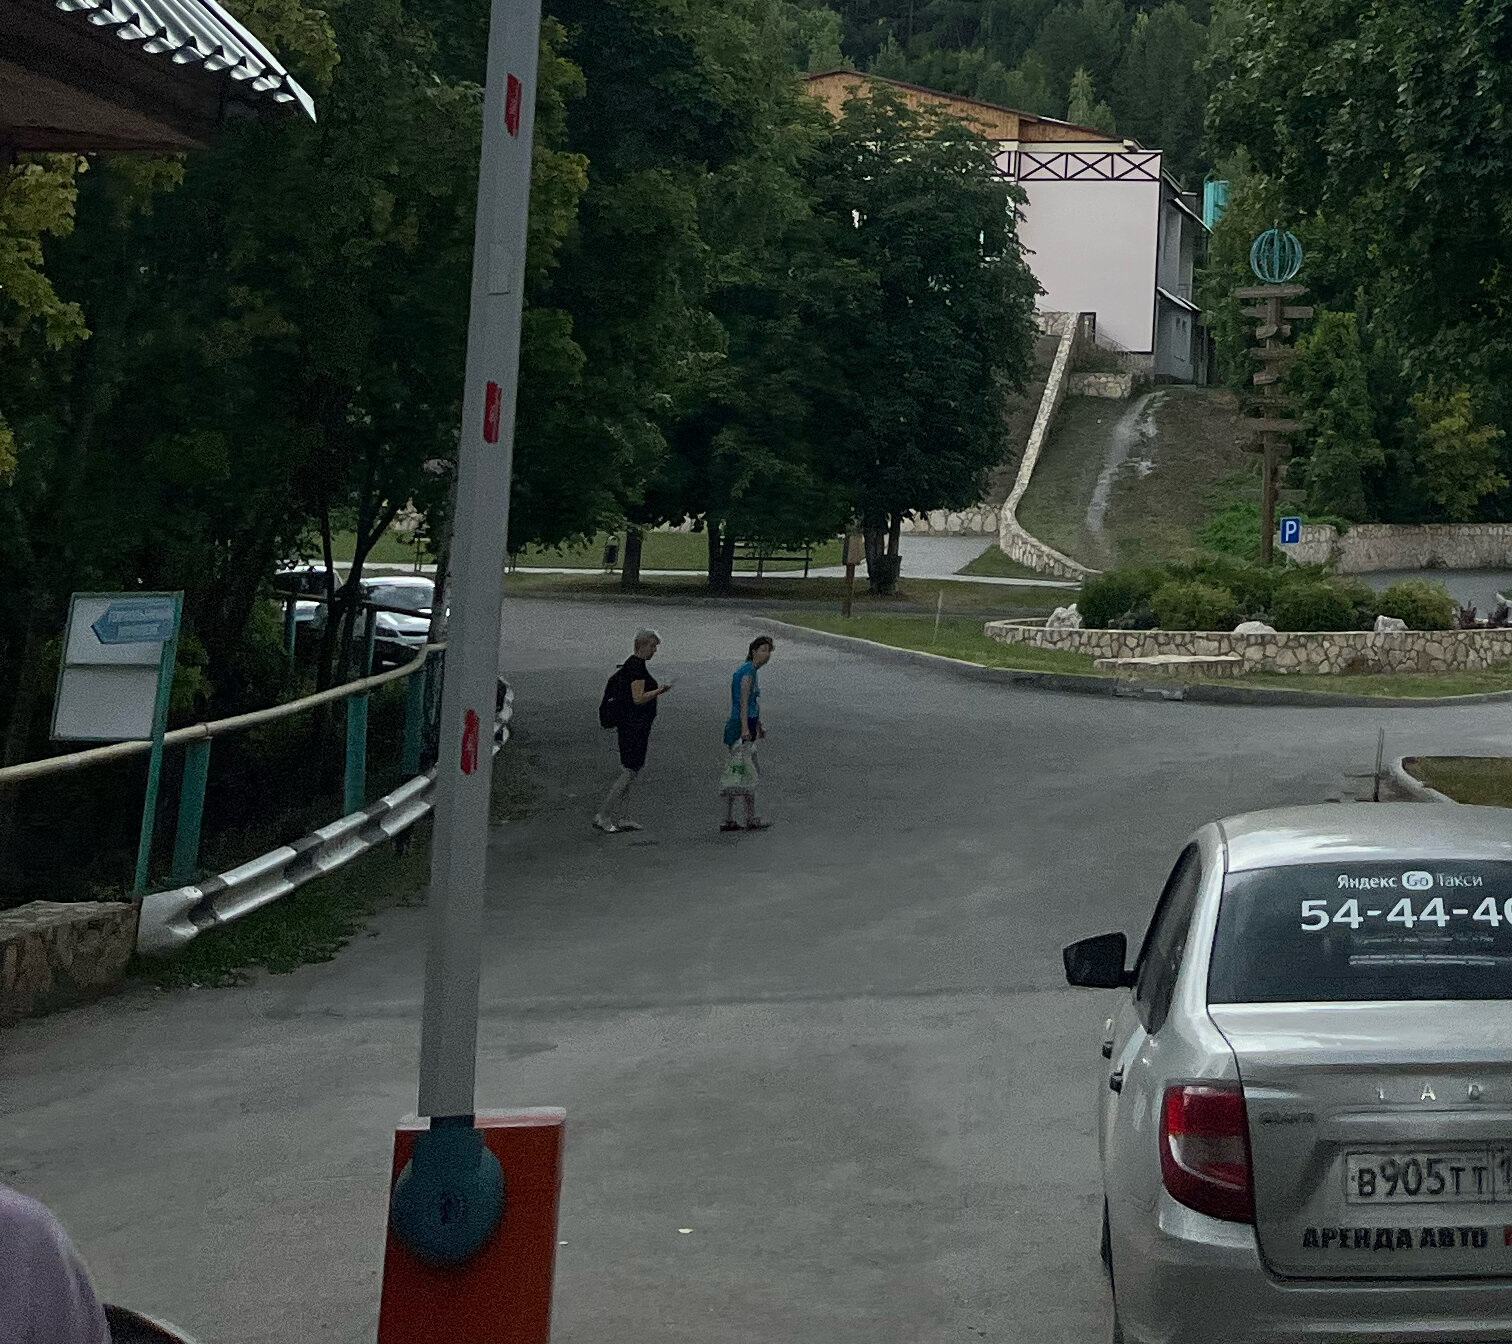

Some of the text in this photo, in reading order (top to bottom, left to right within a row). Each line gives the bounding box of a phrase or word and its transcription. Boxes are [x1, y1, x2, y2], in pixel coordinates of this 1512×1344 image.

[1285, 520, 1298, 542] P
[1337, 874, 1398, 890] Яндекс
[1436, 872, 1483, 887] Такси
[1302, 1226, 1413, 1251] АРЕНДА
[1419, 1225, 1489, 1249] АВТО
